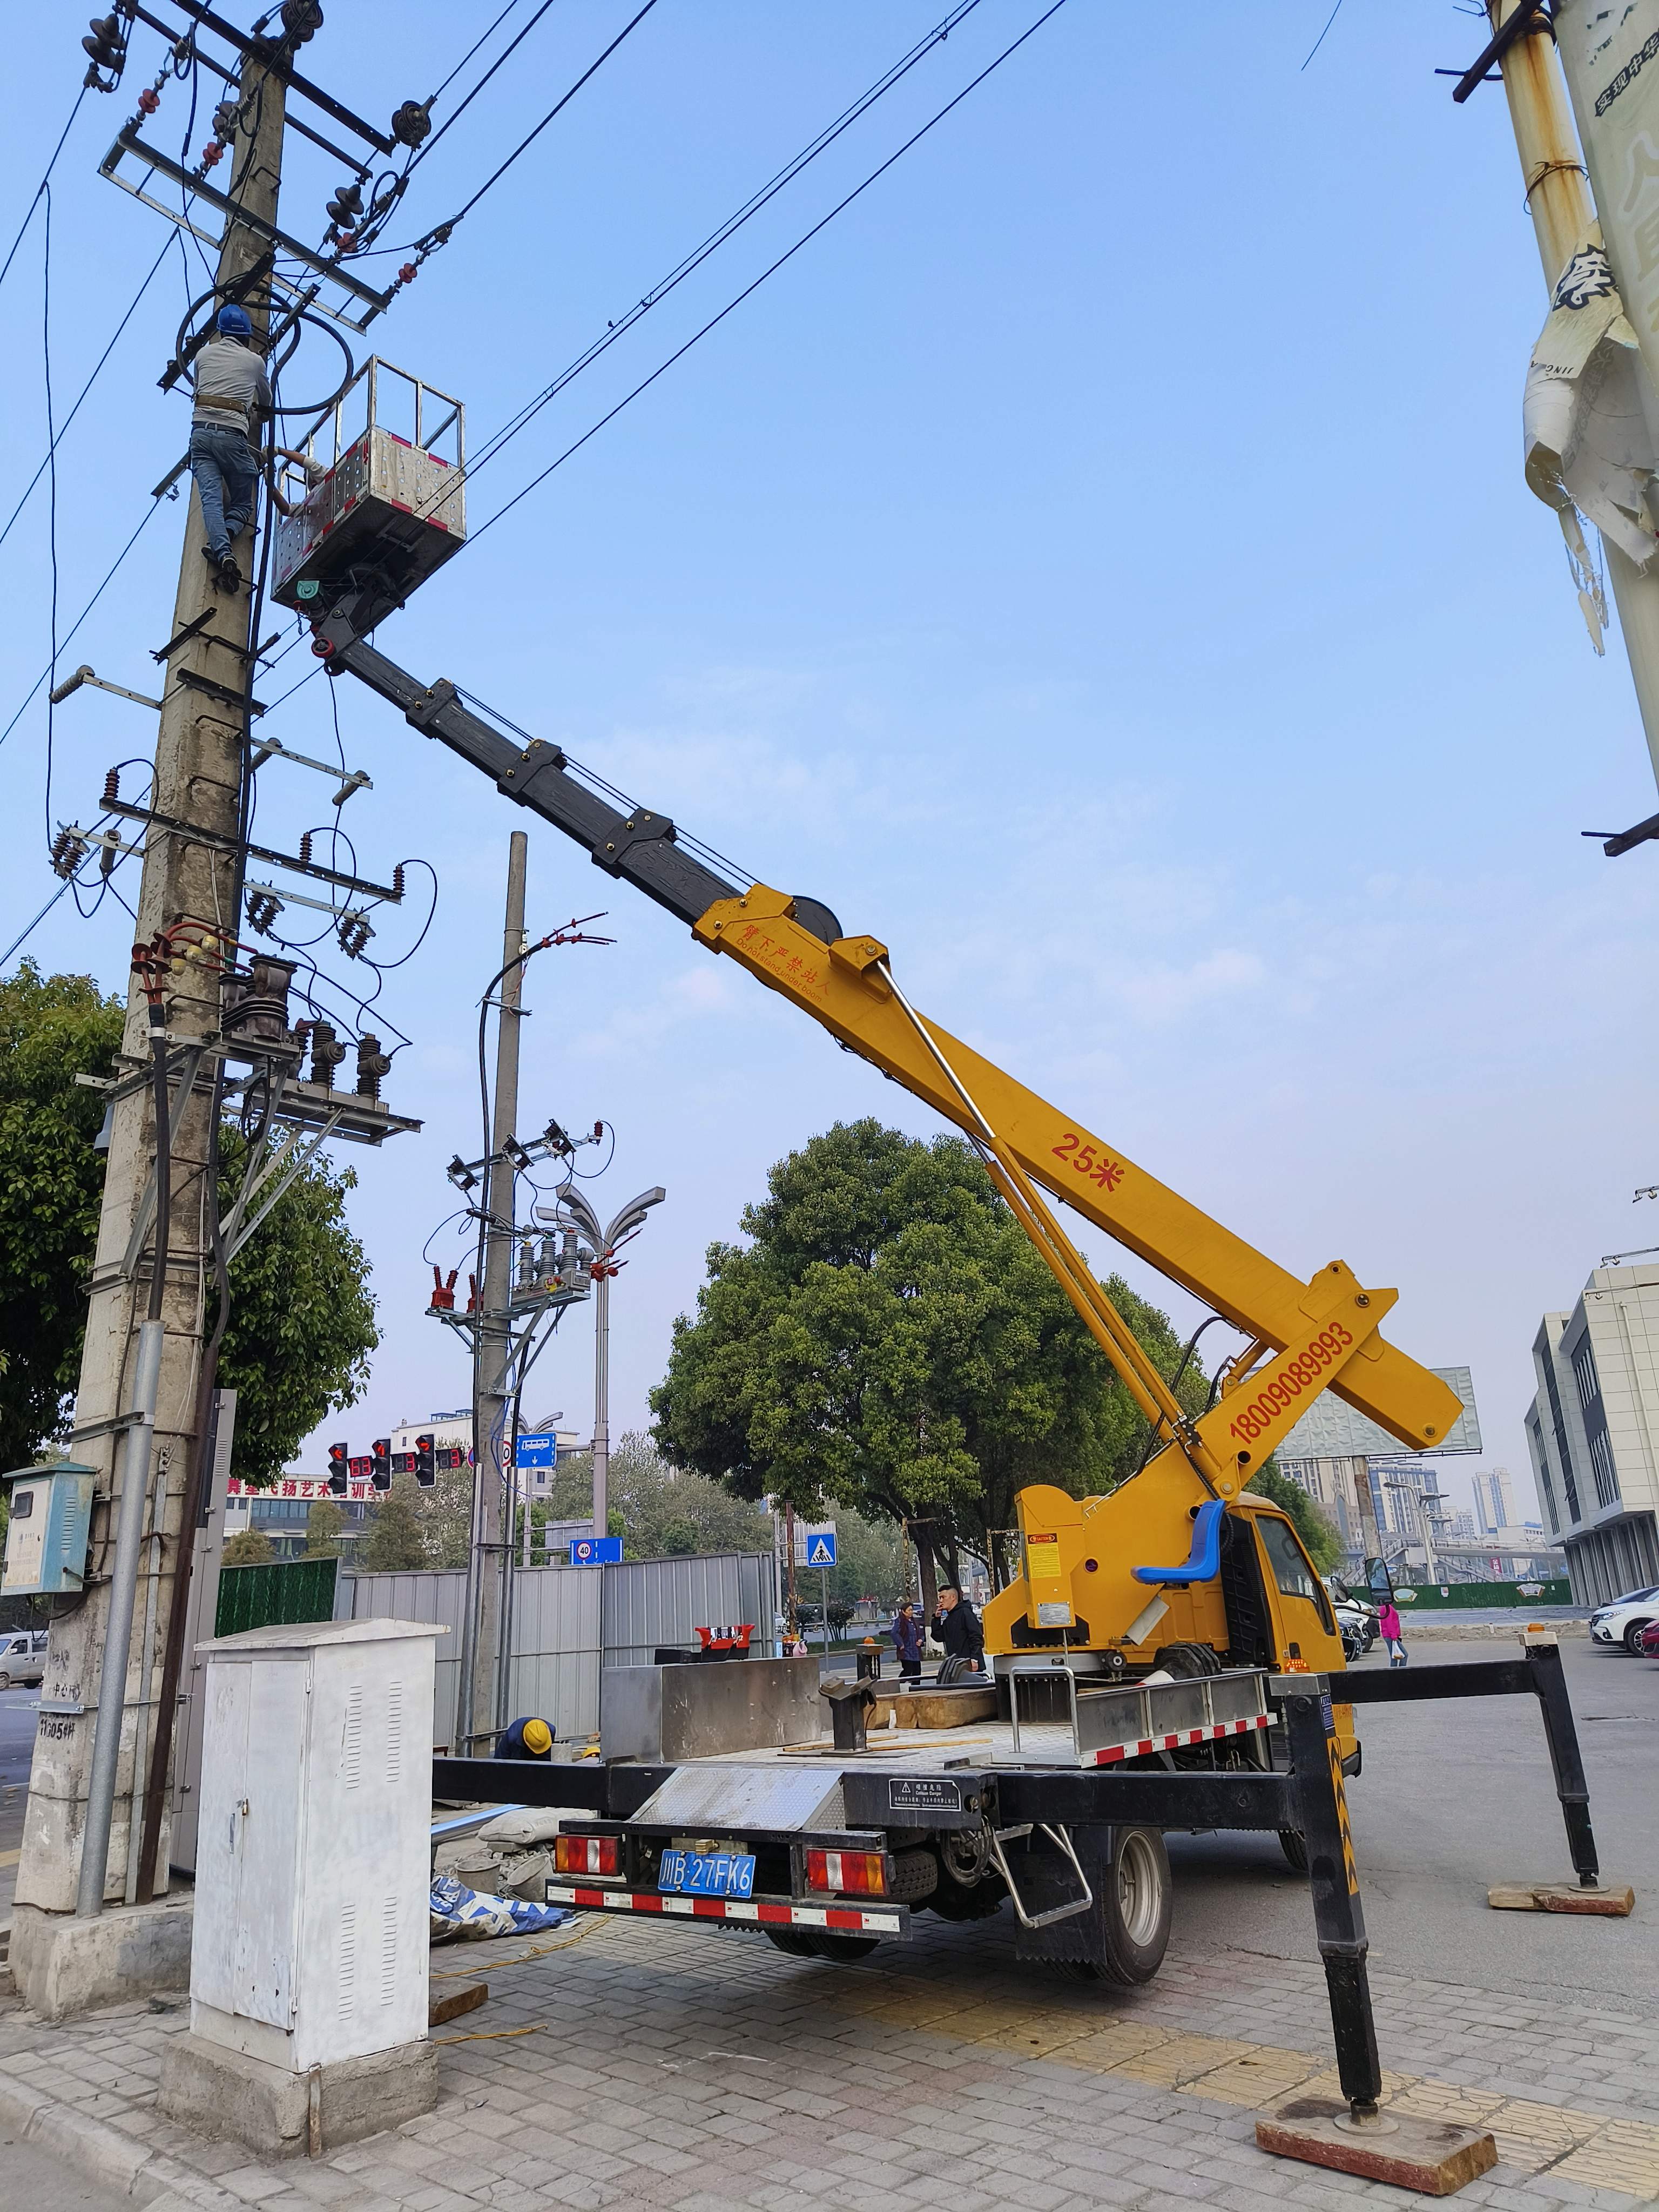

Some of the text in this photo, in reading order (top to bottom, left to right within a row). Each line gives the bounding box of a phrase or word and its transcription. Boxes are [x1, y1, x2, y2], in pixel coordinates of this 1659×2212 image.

[737, 938, 822, 1002] Do not stand under boom
[742, 924, 831, 996] 臂下严禁站人
[1051, 1133, 1125, 1192] 25米
[1230, 1321, 1353, 1445] 18009089993
[351, 1457, 371, 1476] 63
